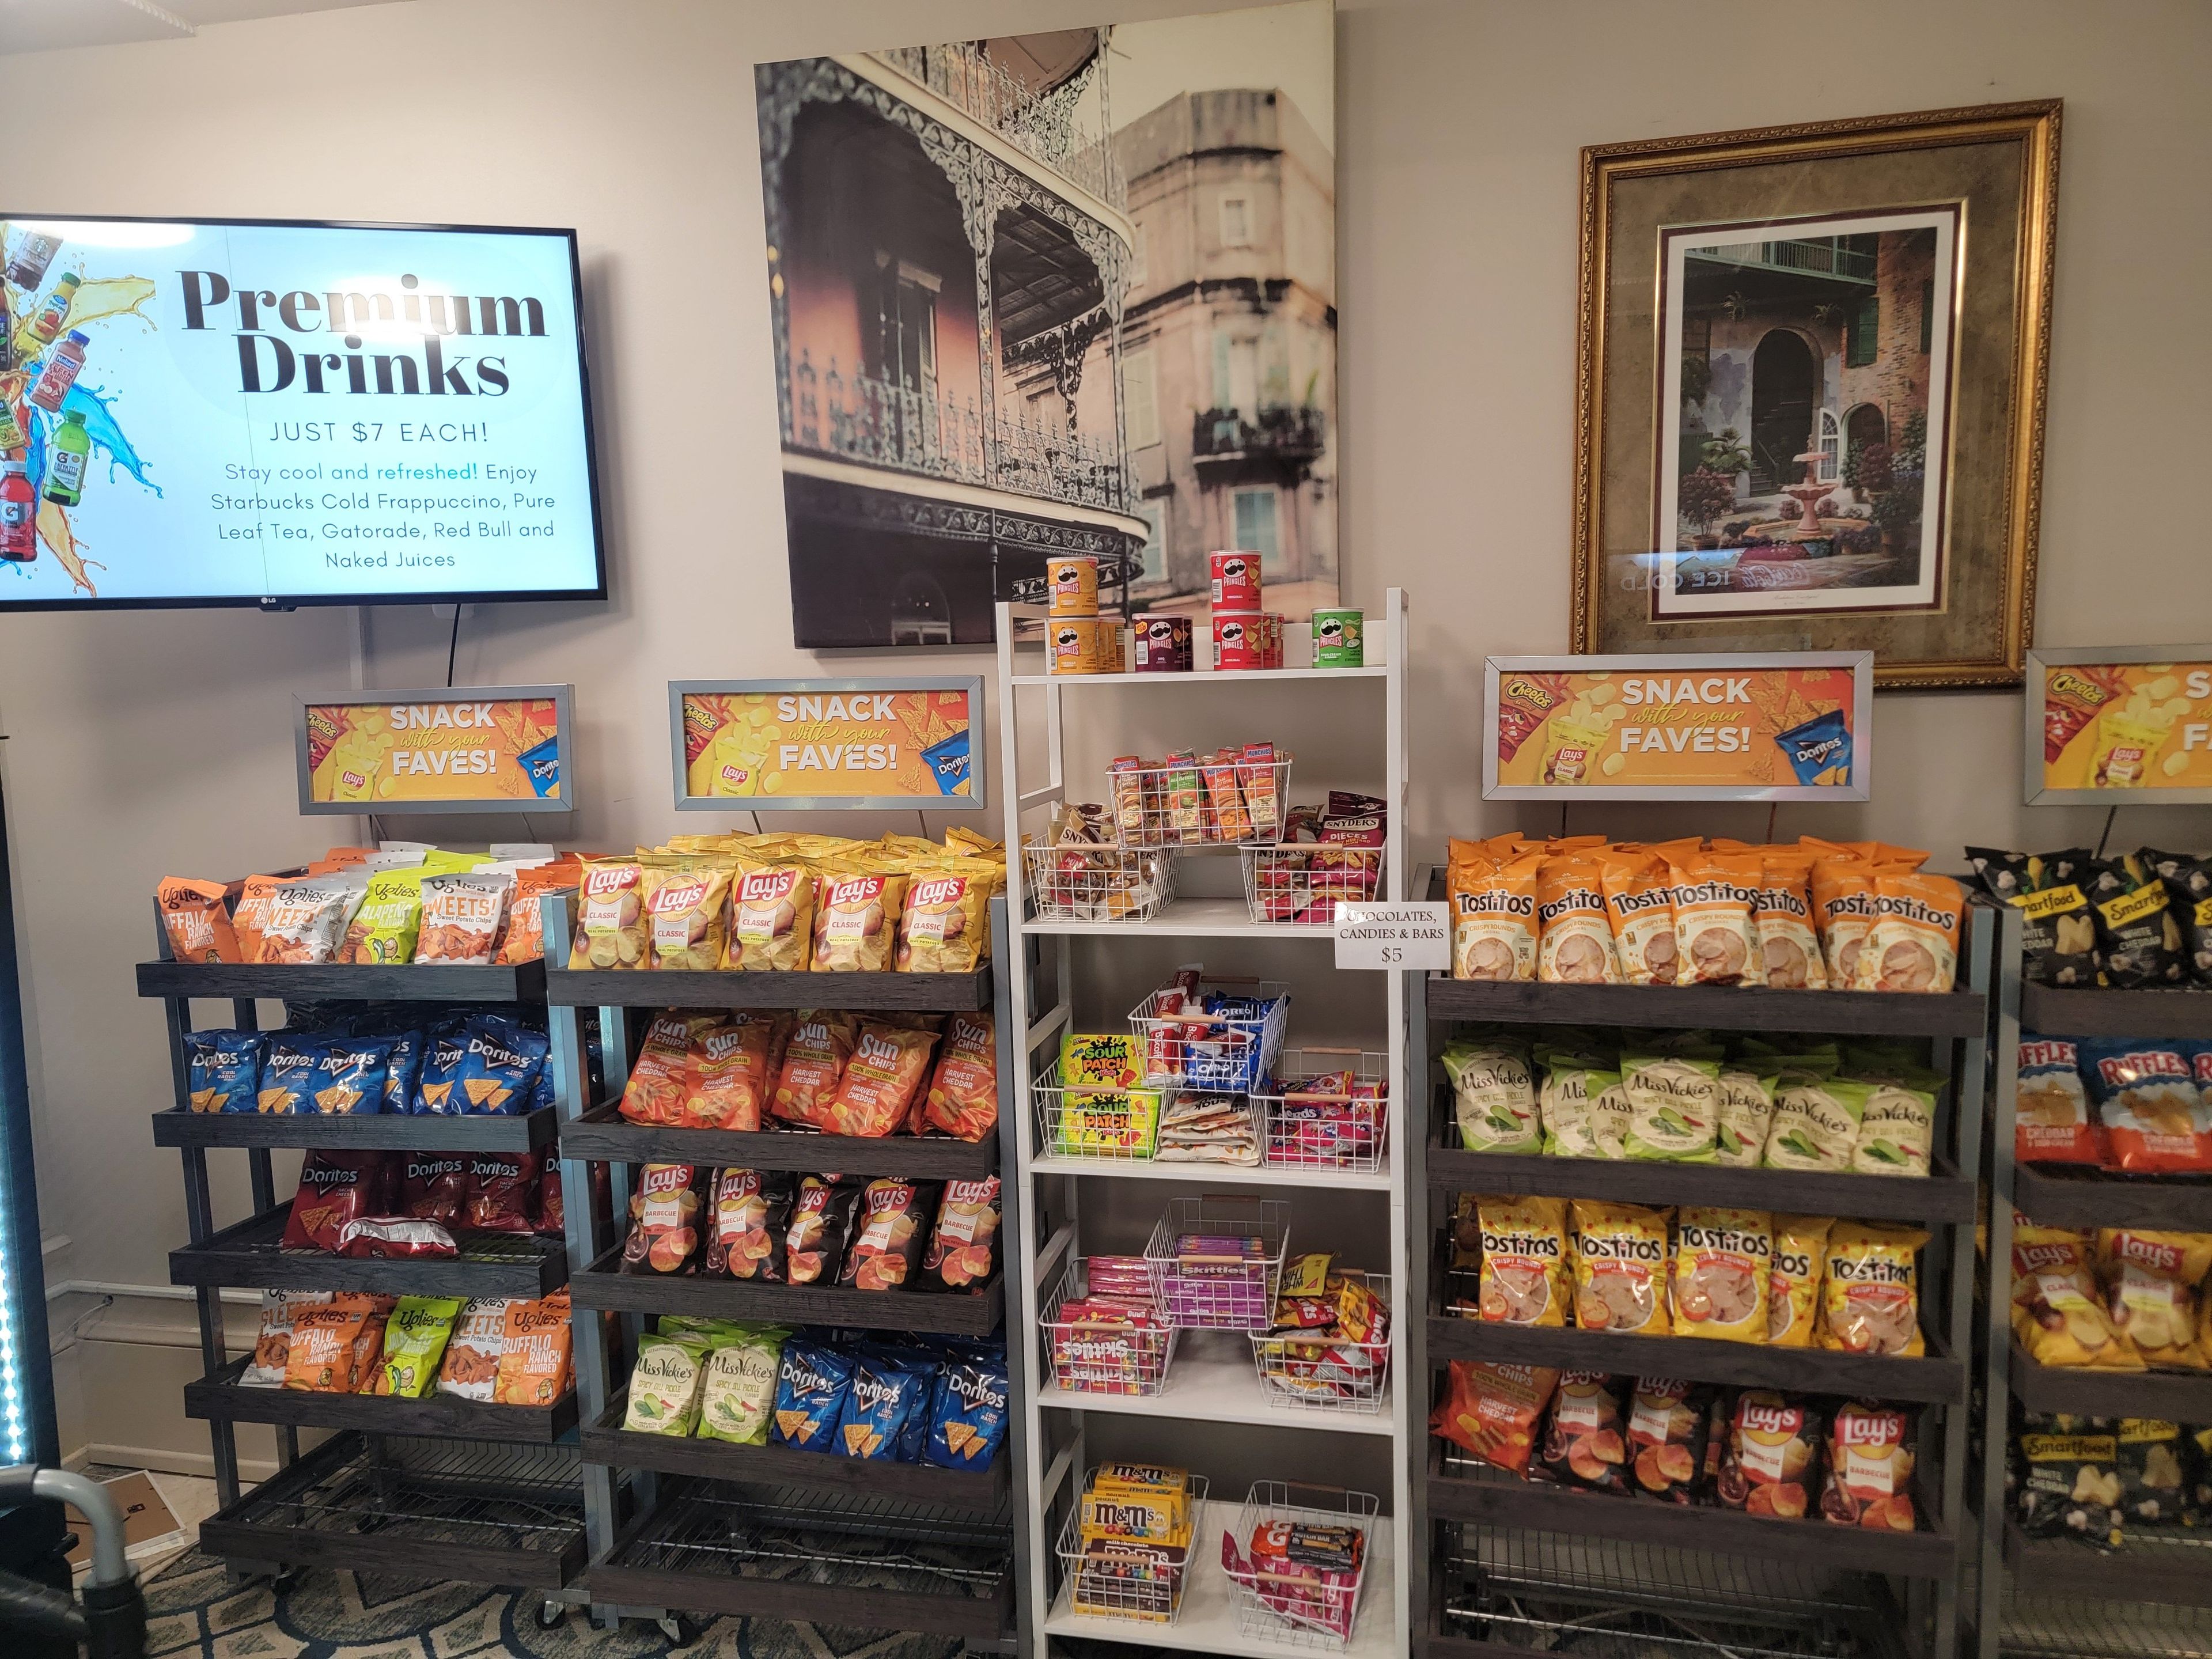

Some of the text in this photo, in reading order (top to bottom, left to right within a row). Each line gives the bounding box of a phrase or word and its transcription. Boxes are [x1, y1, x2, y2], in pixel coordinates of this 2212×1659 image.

[175, 271, 550, 336] Premium
[232, 334, 509, 397] Drinks
[270, 421, 488, 443] JUST $7 EACH!
[225, 462, 537, 485] Stay cool and refreshed! Enjoy
[211, 493, 555, 514] Starbucks Cold Frappuccino, Pure
[218, 520, 554, 541] Leaf Tea, Gatorade, Red Bull and
[325, 551, 455, 568] Naked Juices
[1058, 582, 1079, 593] PRINGLES
[1224, 576, 1245, 586] PRINGLES
[1058, 645, 1079, 655] PRINGLES
[1149, 639, 1172, 649] PRINGLES
[1222, 639, 1243, 650] PRINGLES
[1320, 636, 1342, 647] PRINGLES
[1508, 681, 1552, 708] Cheetos
[1622, 678, 1752, 704] SNACK
[2052, 675, 2103, 703] Cheetos
[390, 703, 495, 730] SNACK
[777, 695, 896, 721] SNACK
[1631, 702, 1744, 738] with your
[401, 728, 491, 760] with your
[789, 721, 890, 756] with your
[1620, 728, 1751, 752] FAVES!
[780, 744, 897, 770] FAVES!
[1248, 748, 1271, 757] MUNCHIES
[1559, 750, 1584, 762] Lay's
[1797, 736, 1842, 761] Doritos
[2113, 747, 2141, 761] Lay's
[393, 749, 496, 775] FAVES!
[1115, 761, 1136, 770] MUNCHIES
[1171, 759, 1194, 768] MUNCHIES
[1557, 766, 1574, 775] CLASSIC
[1330, 832, 1368, 840] PIECES
[588, 867, 634, 895] Lay's
[740, 872, 789, 900] Lay's
[279, 888, 325, 906] Uglies
[375, 883, 420, 900] Uglies
[654, 884, 702, 912] Lay's
[830, 878, 878, 906] Lay's
[914, 877, 960, 907] Lay's
[1457, 889, 1533, 916] Tostitos
[742, 919, 771, 927] CLASSIC
[1347, 911, 1437, 923] CHOCOLATES,
[914, 923, 941, 931] CLASSIC
[1340, 928, 1444, 939] CANDIES & BARS
[1490, 923, 1516, 933] ROUNDS
[1555, 920, 1601, 935] CRISPY ROUNDS
[1381, 946, 1402, 963] $5
[1218, 1007, 1251, 1017] OREO
[655, 1033, 687, 1048] CHIPS
[706, 1032, 738, 1060] Sun
[805, 1038, 831, 1050] CHIPS
[858, 1033, 899, 1060] Sun
[957, 1039, 987, 1054] CHIPS
[1154, 1031, 1165, 1058] Biscoff
[468, 1039, 532, 1069] Doritos
[718, 1046, 743, 1061] CHIPS
[1085, 1046, 1125, 1058] SOUR
[639, 1060, 671, 1071] HARVEST
[868, 1056, 896, 1071] CHIPS
[1082, 1058, 1128, 1072] PATCH
[636, 1067, 668, 1078] CHEDDAR
[703, 1075, 735, 1086] HARVEST
[790, 1075, 820, 1087] CHEDDAR
[792, 1067, 822, 1078] HARVEST
[851, 1065, 898, 1082] 100% WHOLE GRAIN
[944, 1068, 975, 1081] HARVEST
[1460, 1065, 1529, 1092] Miss Vickie's
[700, 1081, 734, 1091] CHEDDAR
[851, 1084, 879, 1097] HARVEST
[942, 1075, 974, 1089] CHEDDAR
[847, 1092, 877, 1106] CHEDDAR
[1087, 1104, 1128, 1115] SOUR
[1085, 1115, 1130, 1128] PATCH
[302, 1167, 358, 1183] Doritos
[408, 1159, 463, 1179] Doritos
[470, 1160, 518, 1177] Doritos
[643, 1165, 688, 1196] Lay's
[944, 1219, 973, 1232] BARBECUE
[1681, 1225, 1769, 1256] Tostitos
[2018, 1245, 2072, 1270] Lay's
[2122, 1233, 2175, 1268] Lay's
[514, 1311, 562, 1332] Uglies
[502, 1334, 552, 1354] BUFFALO
[1062, 1340, 1128, 1359] Skittles
[528, 1350, 561, 1363] RANCH
[523, 1363, 557, 1374] FLAVORED
[634, 1357, 694, 1383] Miss Vickie's
[709, 1357, 774, 1383] Miss Vickie's
[1497, 1366, 1535, 1387] CHIPS
[1480, 1396, 1518, 1414] HARVEST
[980, 1415, 998, 1424] RANCH
[1477, 1405, 1516, 1424] CHEDDAR
[1844, 1412, 1899, 1446] Lay's
[1850, 1466, 1890, 1479] BARBECUE
[1291, 1532, 1316, 1541] PROTEIN
